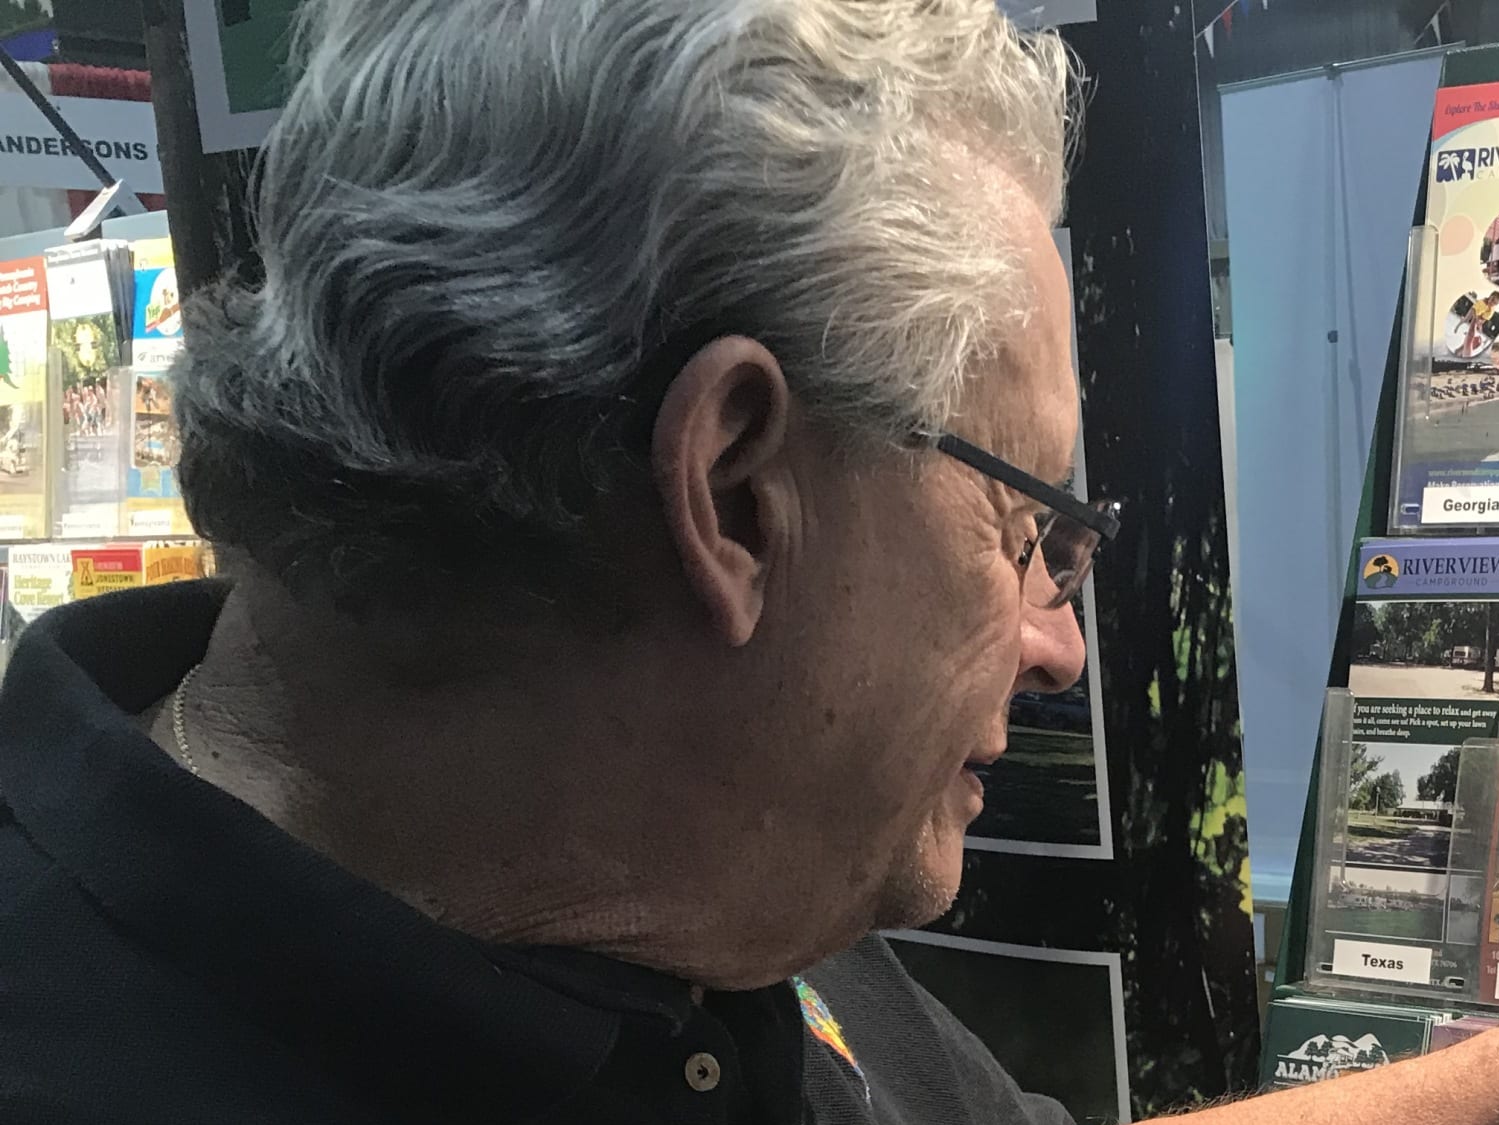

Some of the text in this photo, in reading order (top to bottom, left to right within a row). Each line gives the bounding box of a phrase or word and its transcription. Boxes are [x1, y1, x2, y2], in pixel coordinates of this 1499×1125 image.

[1443, 499, 1499, 512] Georgia
[1416, 577, 1488, 586] CAMPGROUND
[1362, 954, 1404, 970] Texas
